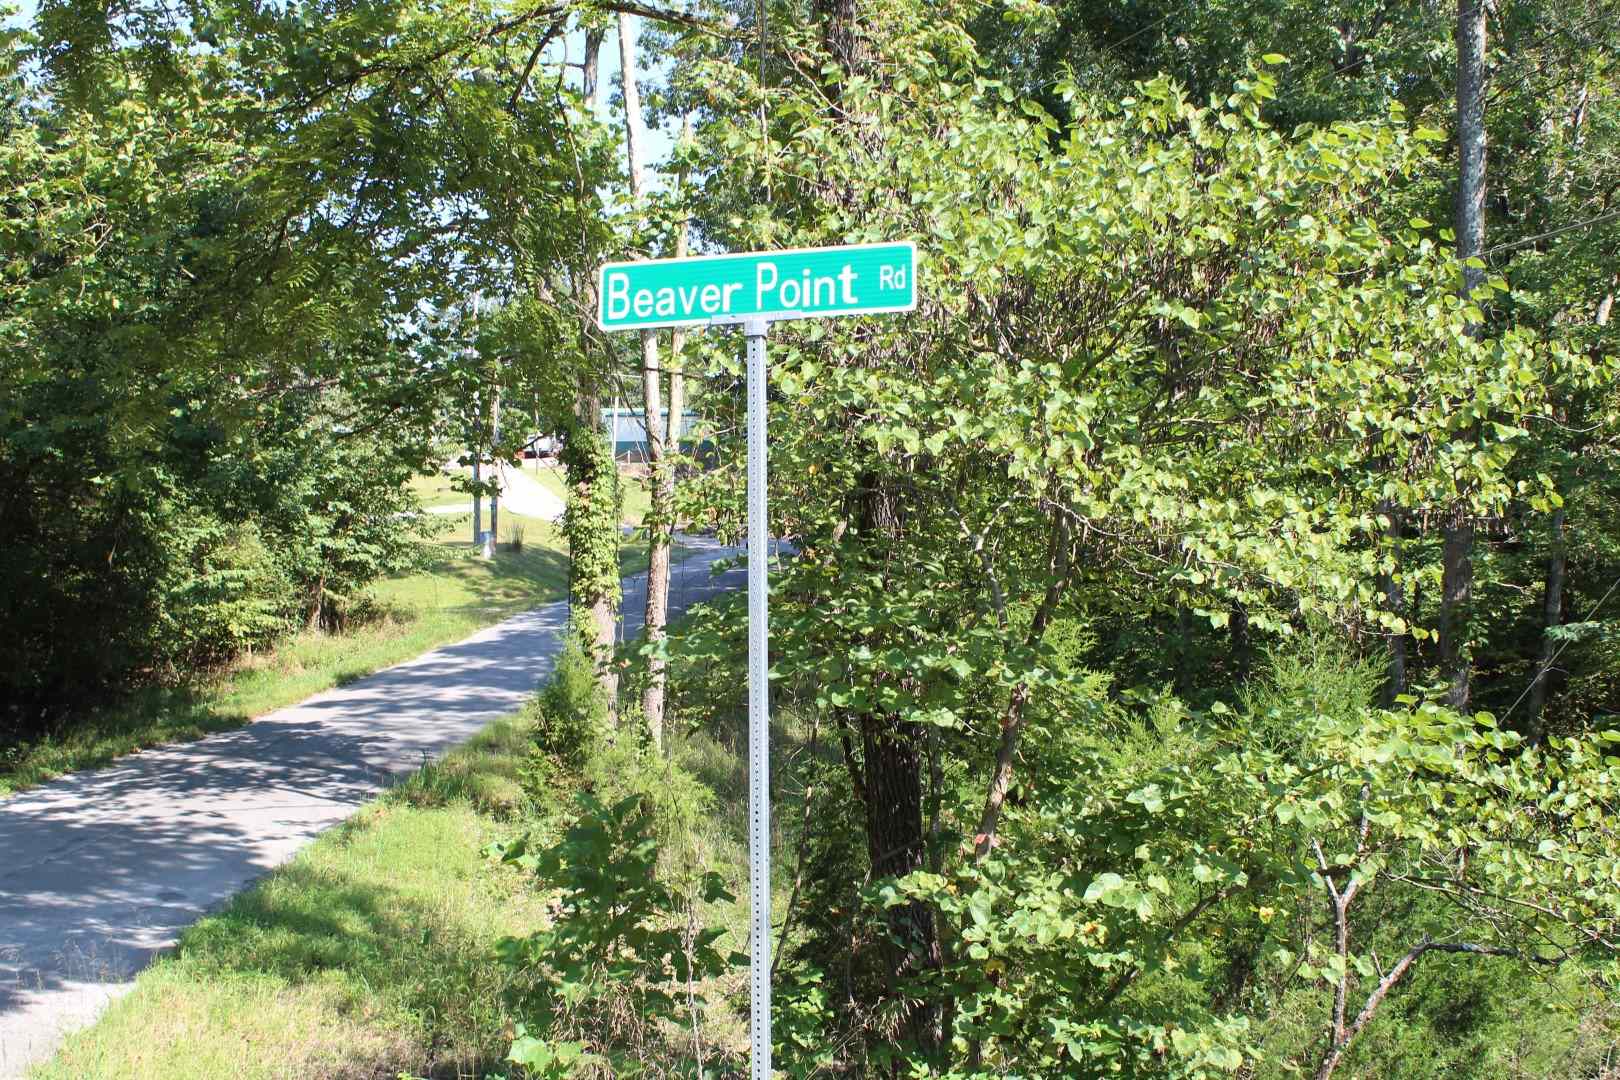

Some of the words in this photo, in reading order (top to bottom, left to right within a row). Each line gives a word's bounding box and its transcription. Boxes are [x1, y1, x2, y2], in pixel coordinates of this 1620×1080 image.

[607, 272, 744, 320] Beaver
[756, 261, 859, 311] Point
[879, 264, 906, 291] Rd
